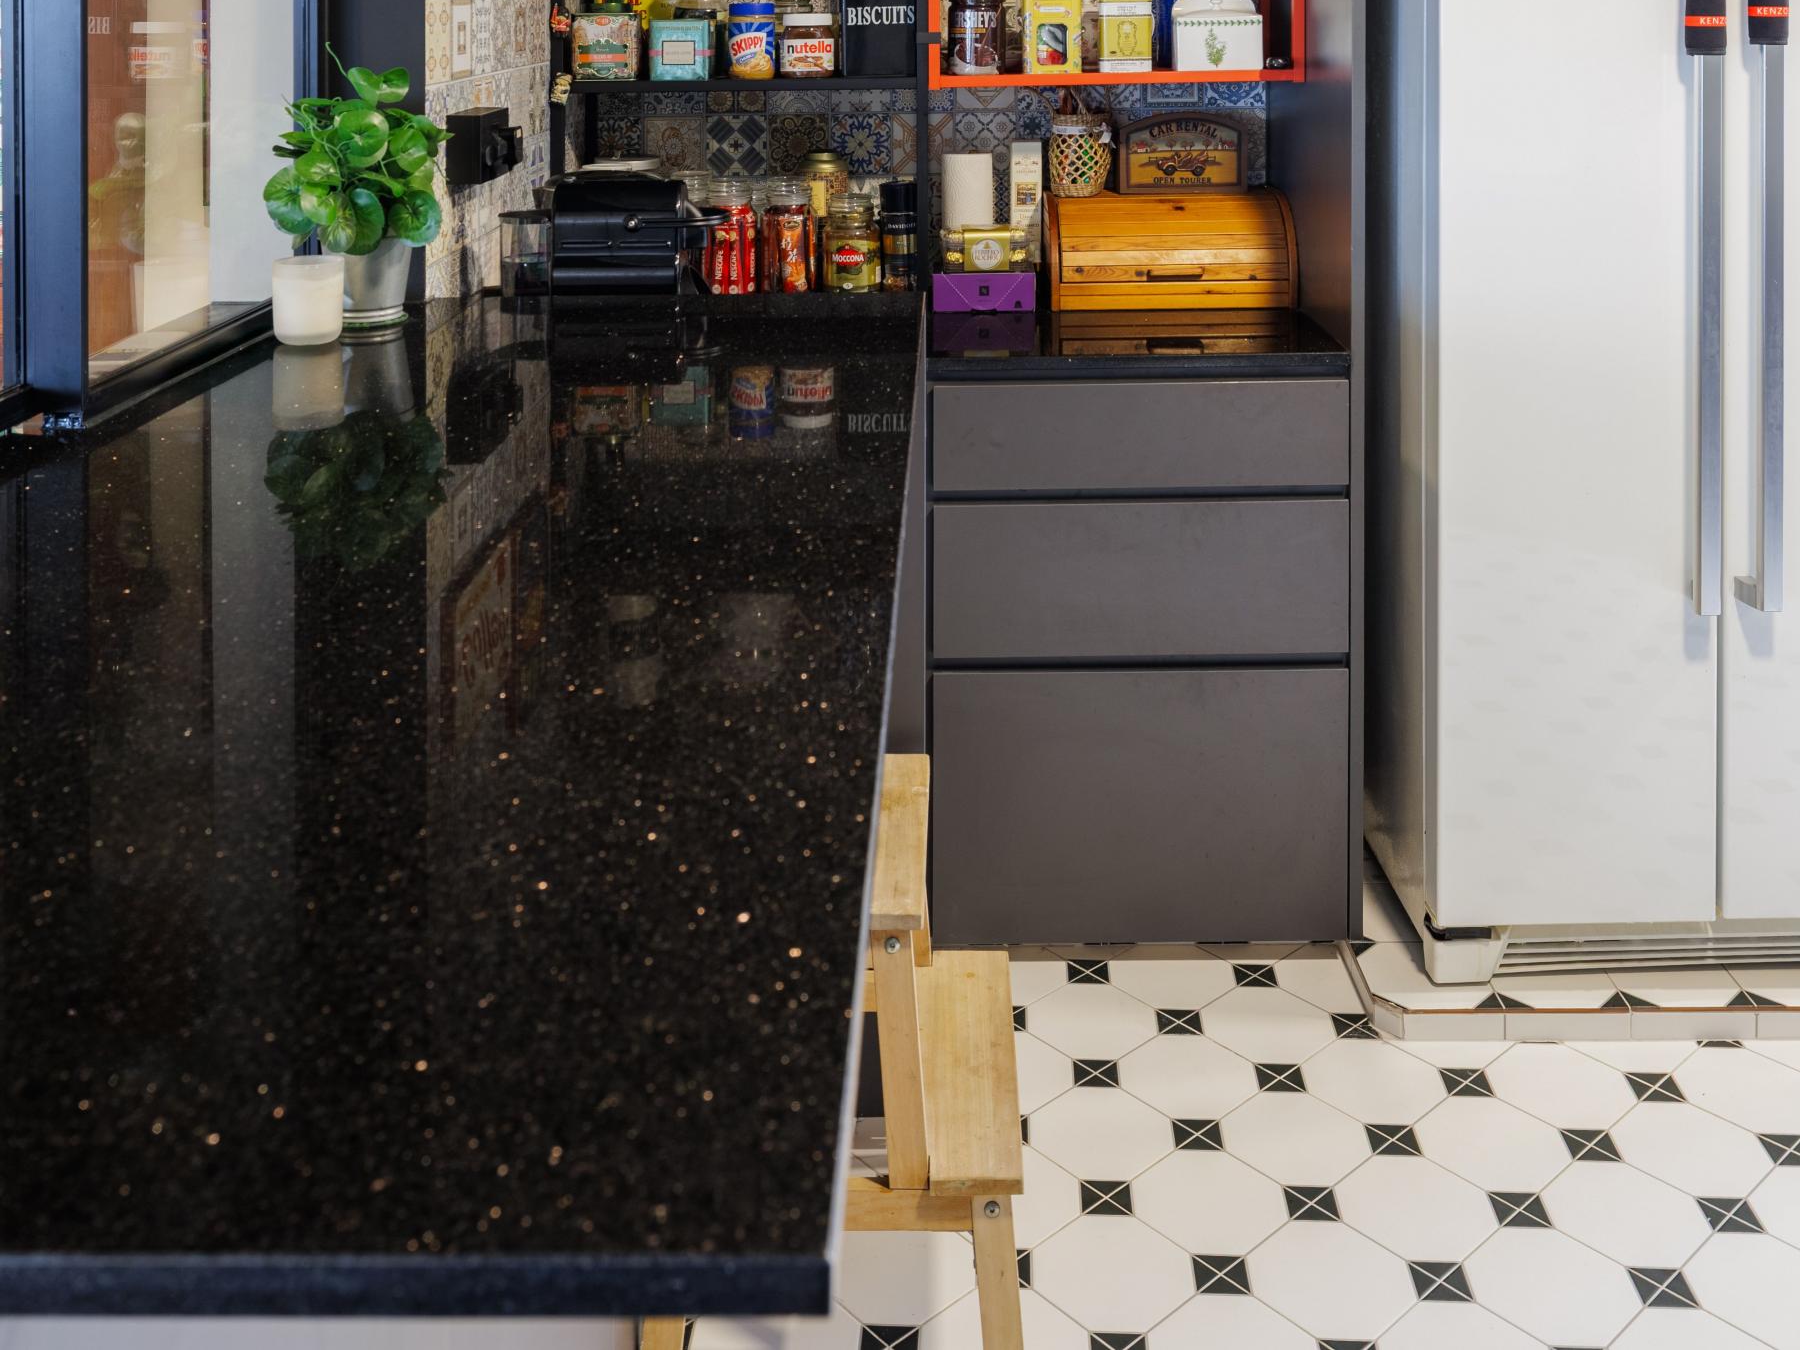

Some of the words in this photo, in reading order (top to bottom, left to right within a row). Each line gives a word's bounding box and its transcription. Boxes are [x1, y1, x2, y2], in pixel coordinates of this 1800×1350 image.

[847, 5, 915, 26] BISCUITS
[954, 11, 997, 28] ERSHEY'S
[731, 35, 764, 57] SKIPPY
[787, 42, 832, 54] nutella
[1149, 124, 1174, 138] CAR
[1175, 121, 1217, 138] RENTAL
[1153, 176, 1175, 185] OPEN
[1180, 176, 1211, 185] TOURER
[832, 254, 865, 263] MOCCONA
